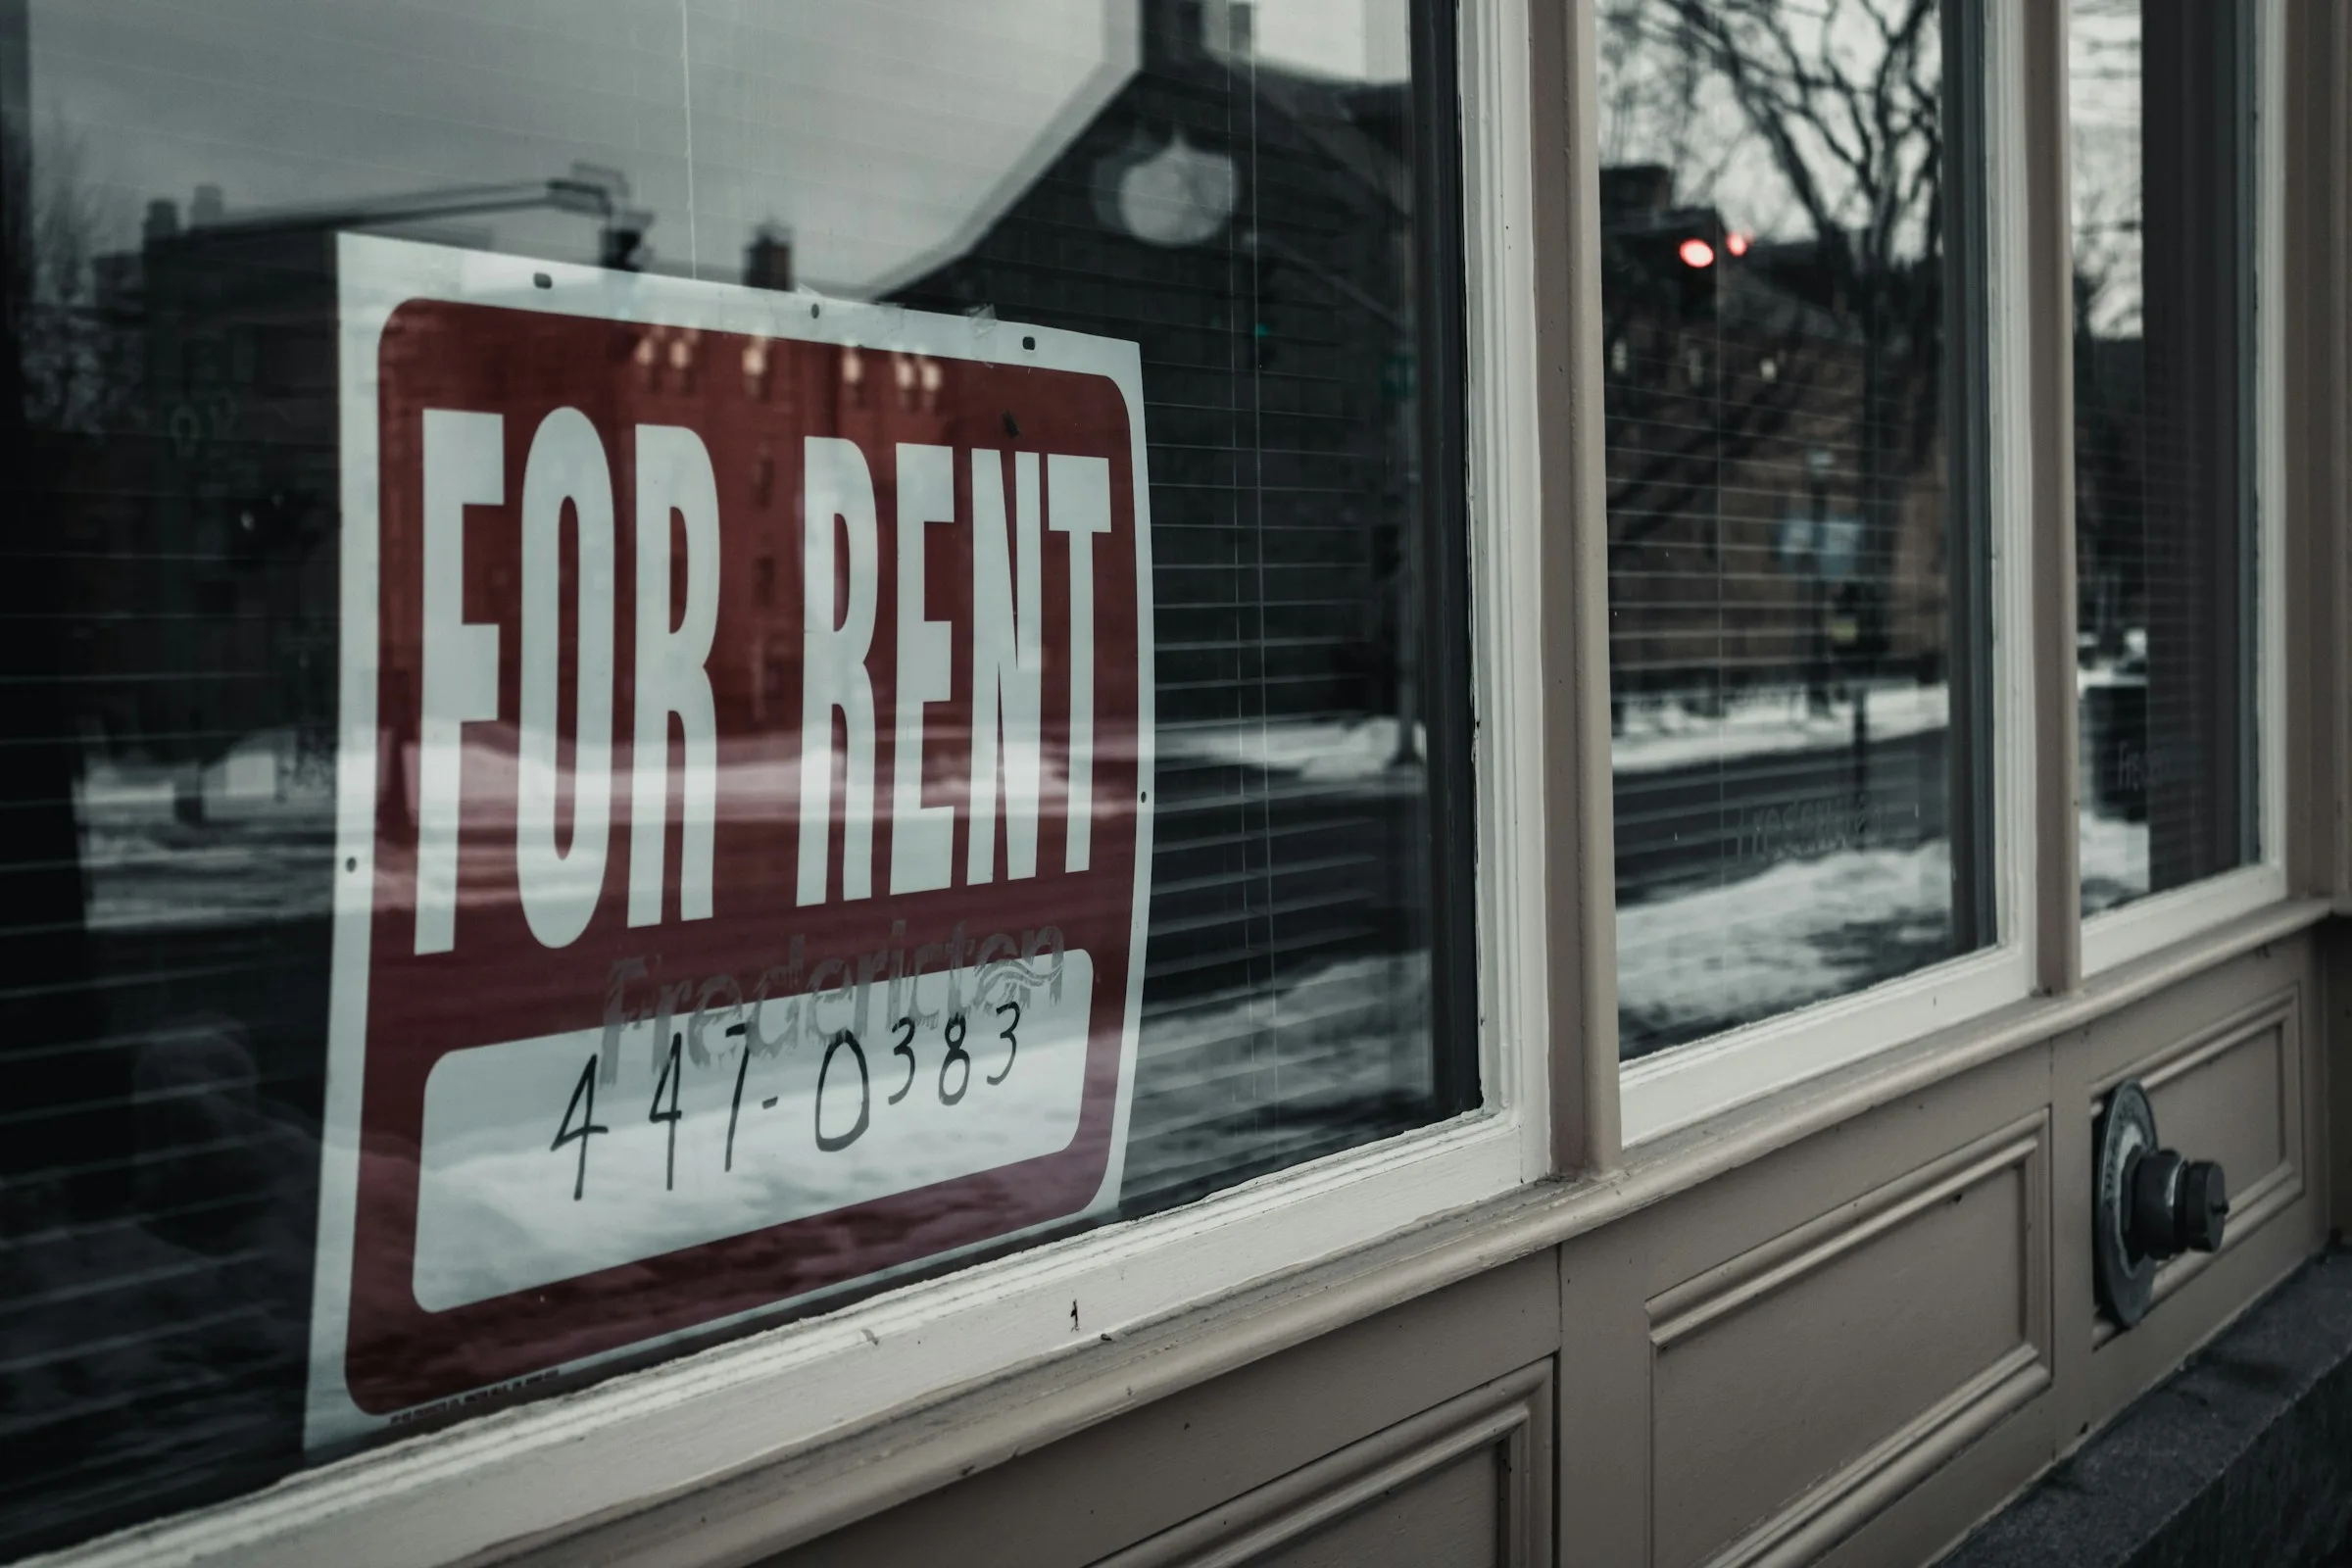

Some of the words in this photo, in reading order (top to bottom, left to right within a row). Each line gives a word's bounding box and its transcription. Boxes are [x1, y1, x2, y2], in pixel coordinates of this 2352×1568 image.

[414, 406, 721, 956] FOR
[796, 435, 1112, 907] RENT
[550, 1001, 1021, 1200] 447-0383
[598, 918, 1065, 1089] Fredericton
